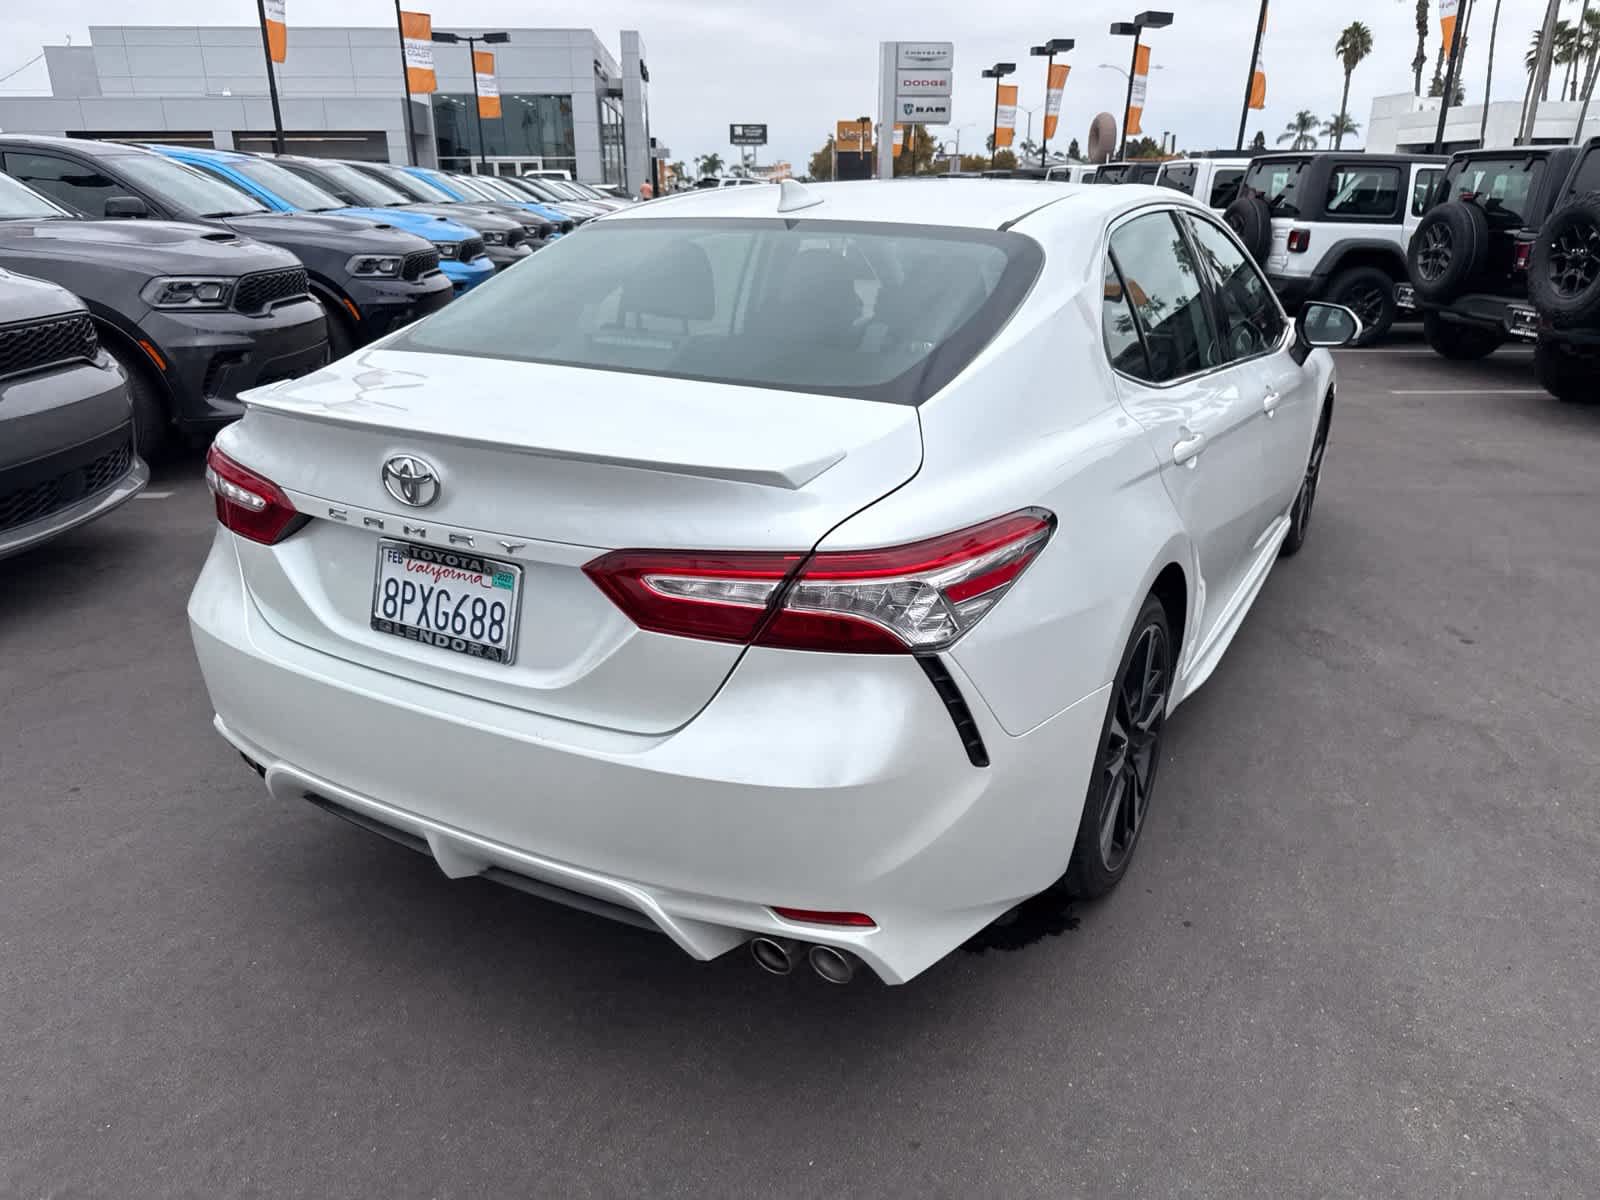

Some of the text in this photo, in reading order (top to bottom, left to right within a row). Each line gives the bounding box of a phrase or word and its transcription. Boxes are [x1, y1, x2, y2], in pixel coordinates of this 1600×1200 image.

[903, 79, 947, 87] DODGE
[328, 507, 526, 554] CAMRY
[387, 550, 404, 565] FEB
[410, 547, 482, 573] TOYOTA
[405, 558, 492, 588] California
[382, 577, 506, 644] 8PXG688
[378, 619, 501, 663] GLENDORA
